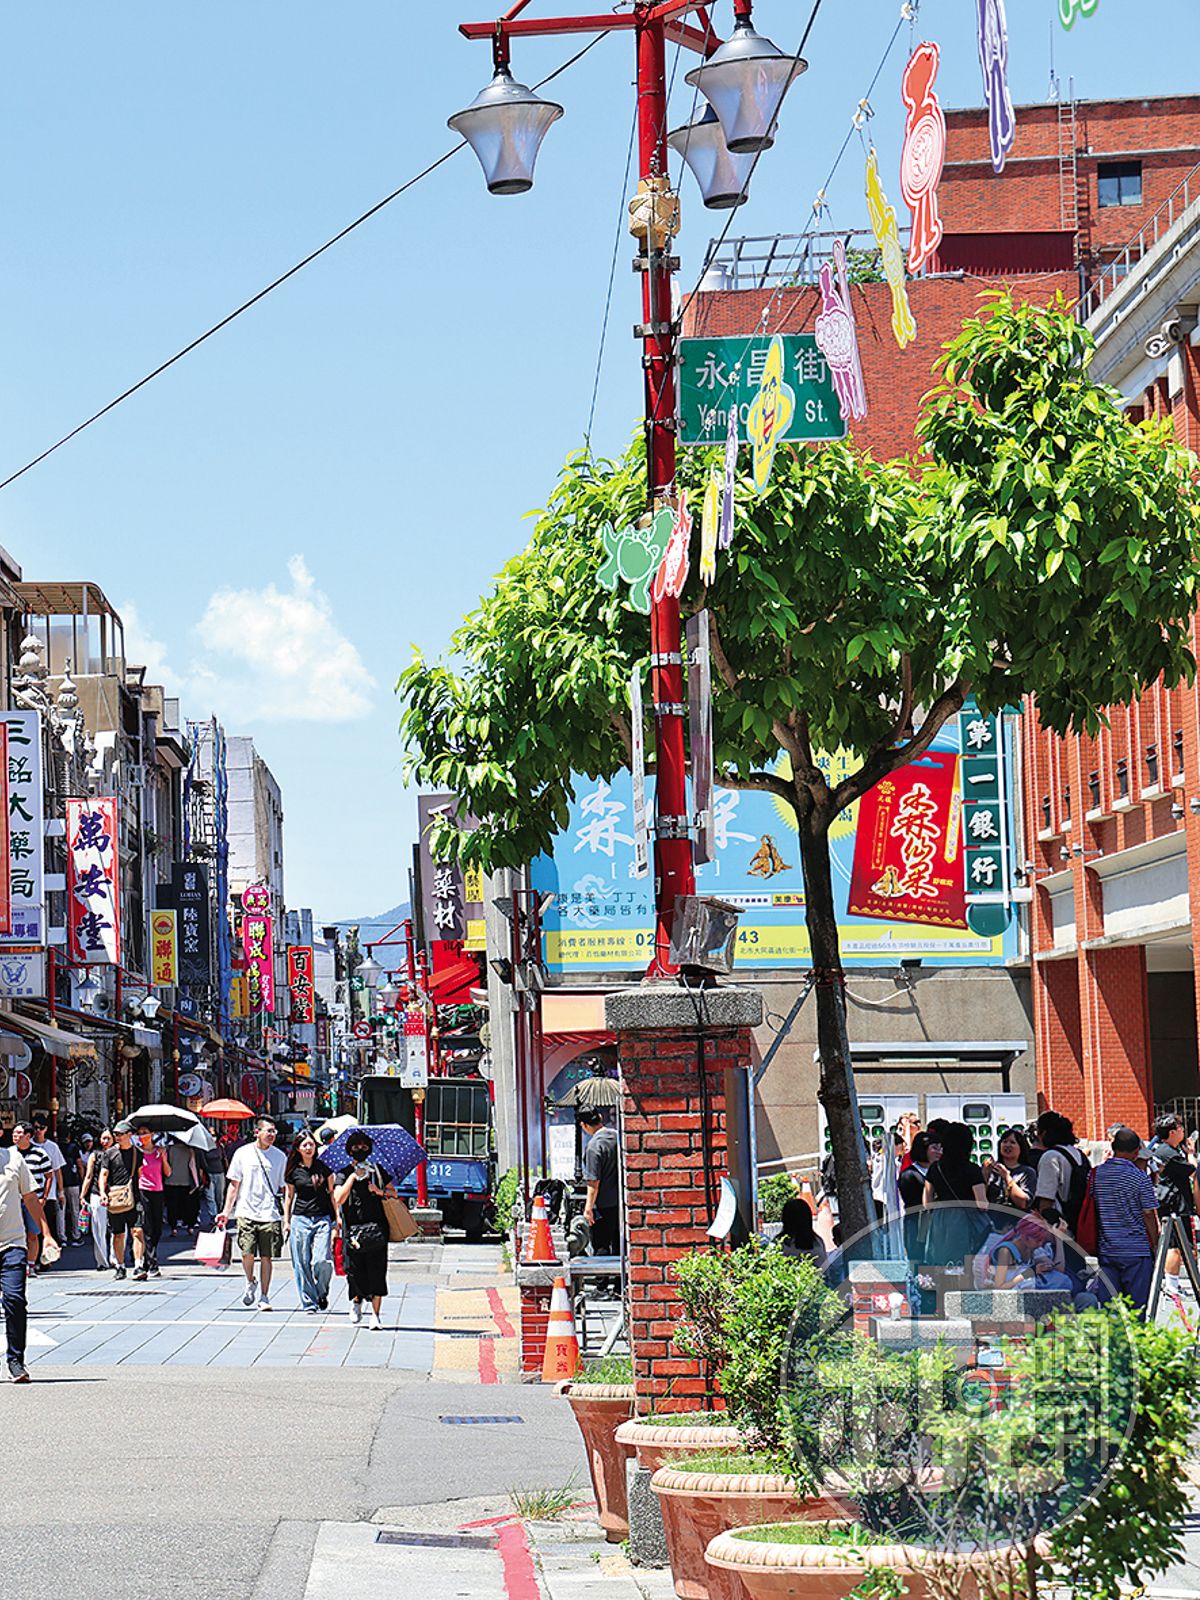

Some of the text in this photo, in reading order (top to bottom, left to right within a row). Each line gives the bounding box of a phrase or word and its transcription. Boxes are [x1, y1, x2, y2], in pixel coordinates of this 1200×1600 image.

[696, 348, 828, 390] 永昌街
[805, 399, 828, 423] St.
[966, 718, 999, 886] 第一銀行
[73, 810, 113, 951] 萬安堂
[738, 930, 759, 944] 43
[290, 950, 313, 1021] 百安堂
[430, 1164, 452, 1176] 312
